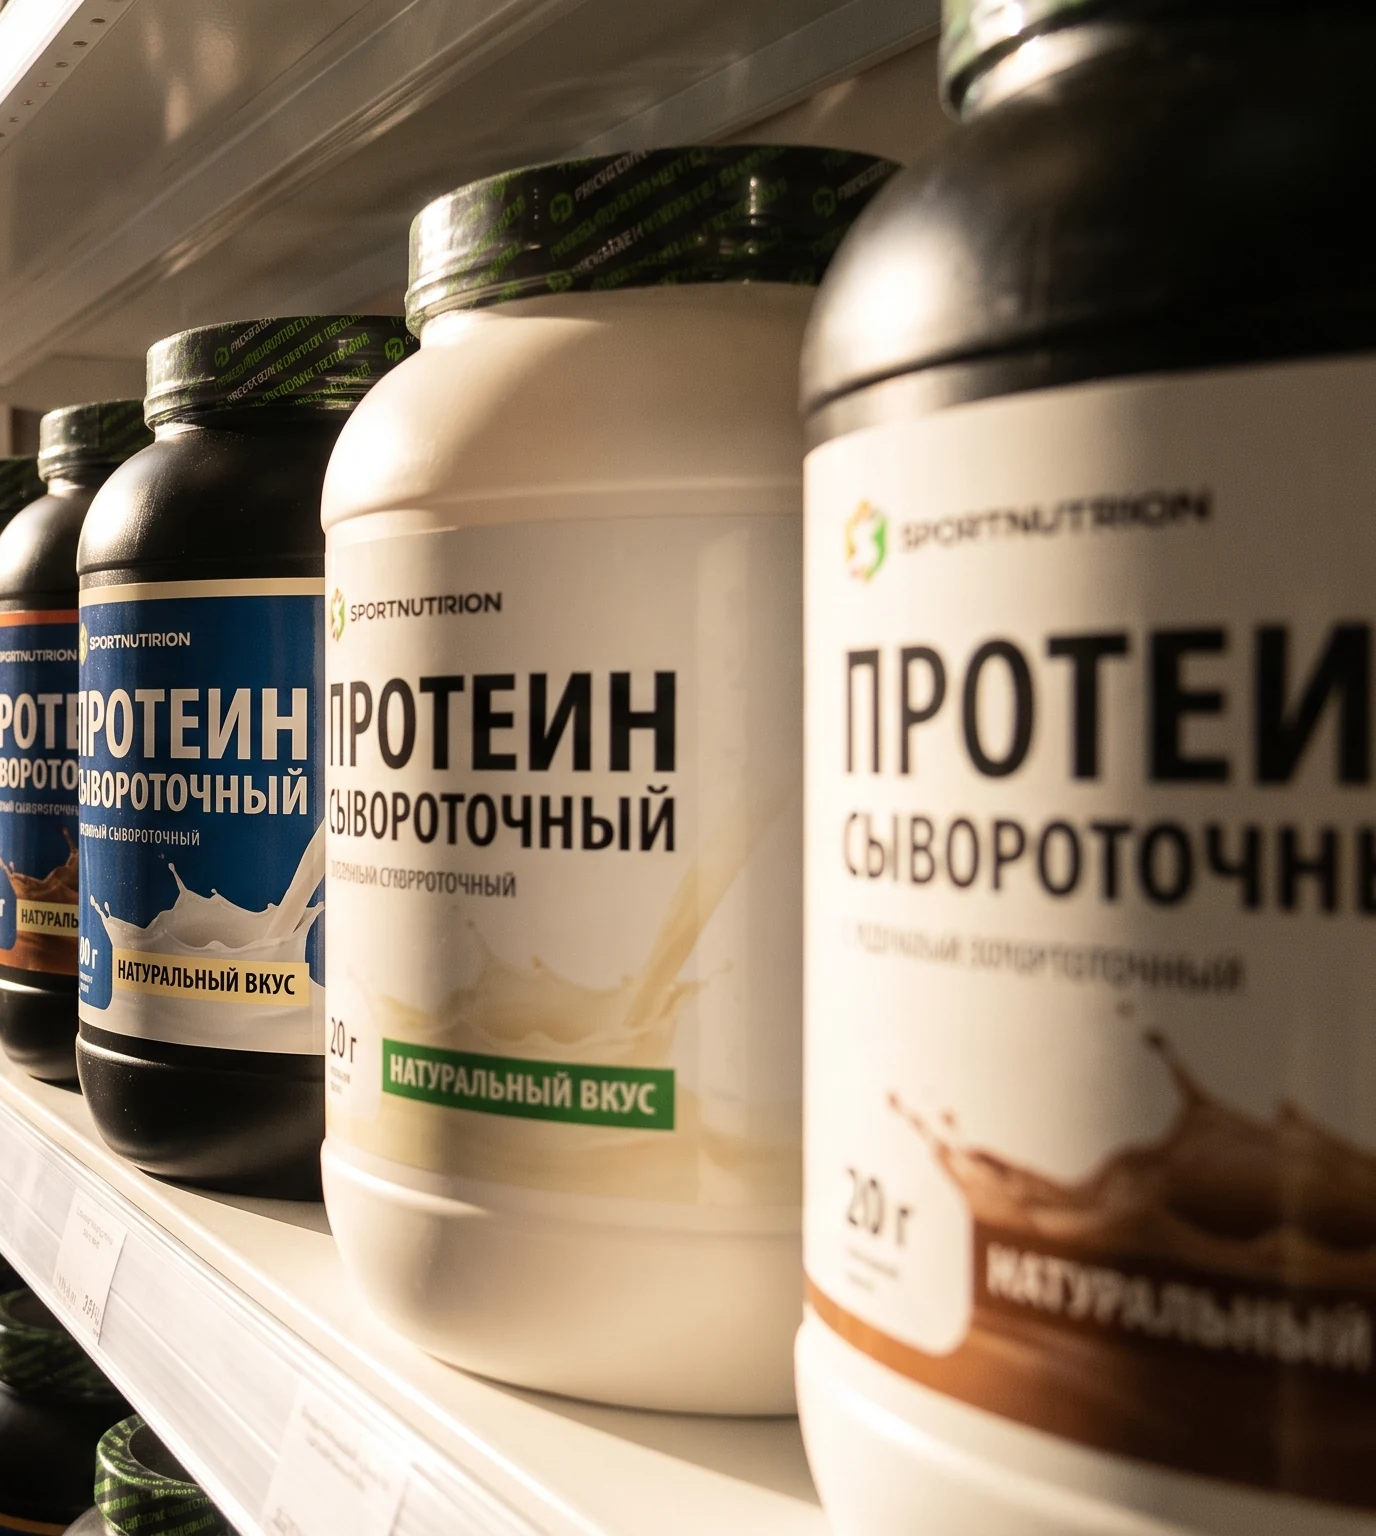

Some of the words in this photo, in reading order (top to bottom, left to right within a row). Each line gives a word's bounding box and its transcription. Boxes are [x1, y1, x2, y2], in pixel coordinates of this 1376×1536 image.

[78, 687, 309, 762] ПРОТЕИН
[330, 669, 677, 772] ПРОТЕИН
[78, 768, 309, 816] СЫВОРОТОЧНЫЙ
[108, 826, 200, 847] СЫВОРОТОЧНЫЙ
[329, 784, 676, 852] СЫВОРОТОЧНЫЙ
[91, 948, 99, 970] г
[117, 958, 239, 993] НАТУРАЛЬНЫЙ
[245, 971, 296, 997] ВКУС
[350, 1035, 358, 1064] г
[390, 1053, 573, 1110] НАТУРАЛЬНЫЙ
[580, 1077, 657, 1116] ВКУС
